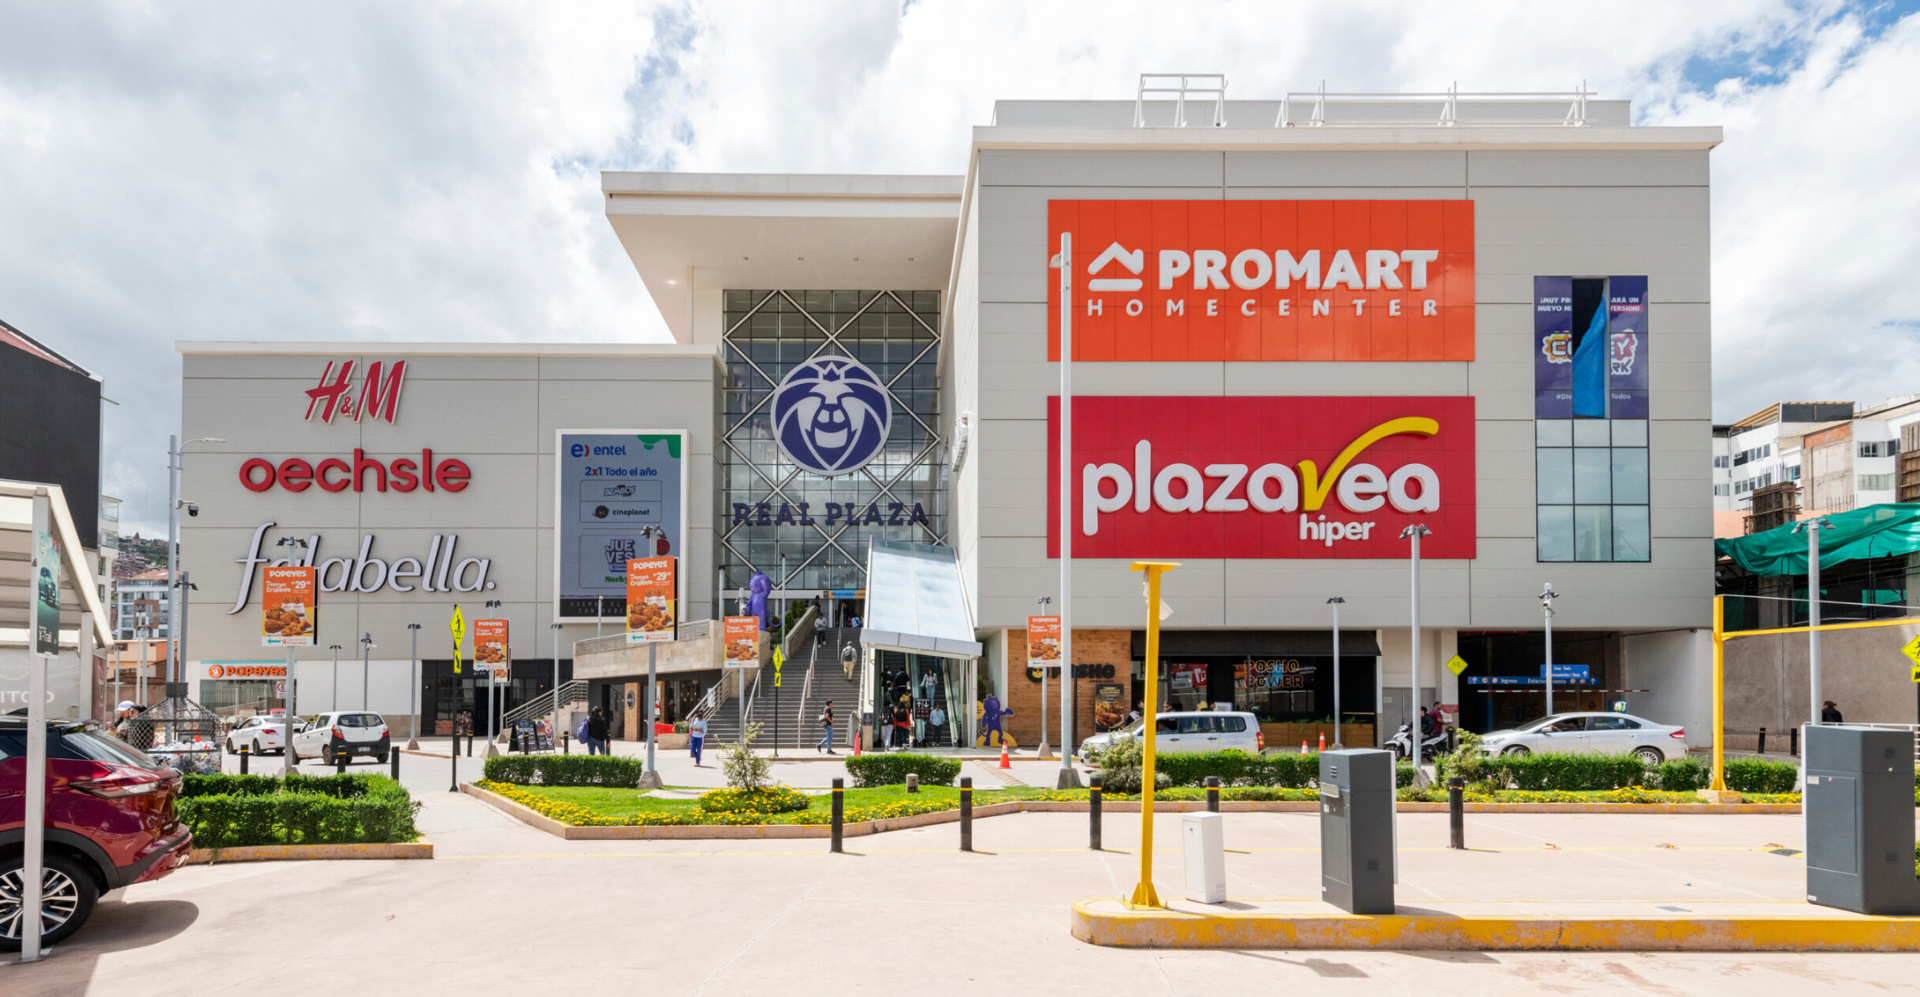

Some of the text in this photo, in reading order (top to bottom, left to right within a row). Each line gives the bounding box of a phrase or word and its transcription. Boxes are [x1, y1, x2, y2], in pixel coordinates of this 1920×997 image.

[1158, 248, 1440, 291] PROMART
[1087, 299, 1438, 317] HOMECENTER
[304, 359, 407, 425] H&M
[594, 445, 627, 456] entel
[239, 448, 472, 492] oechsle
[585, 466, 658, 476] 2x1 Todo el año
[612, 508, 650, 517] cineplanet
[732, 502, 929, 526] REAL PLAZA
[1299, 513, 1376, 547] hiper
[604, 539, 635, 552] JUE
[38, 630, 52, 643] X-Trail
[1243, 659, 1300, 673] POSHO
[1244, 673, 1304, 688] POWER
